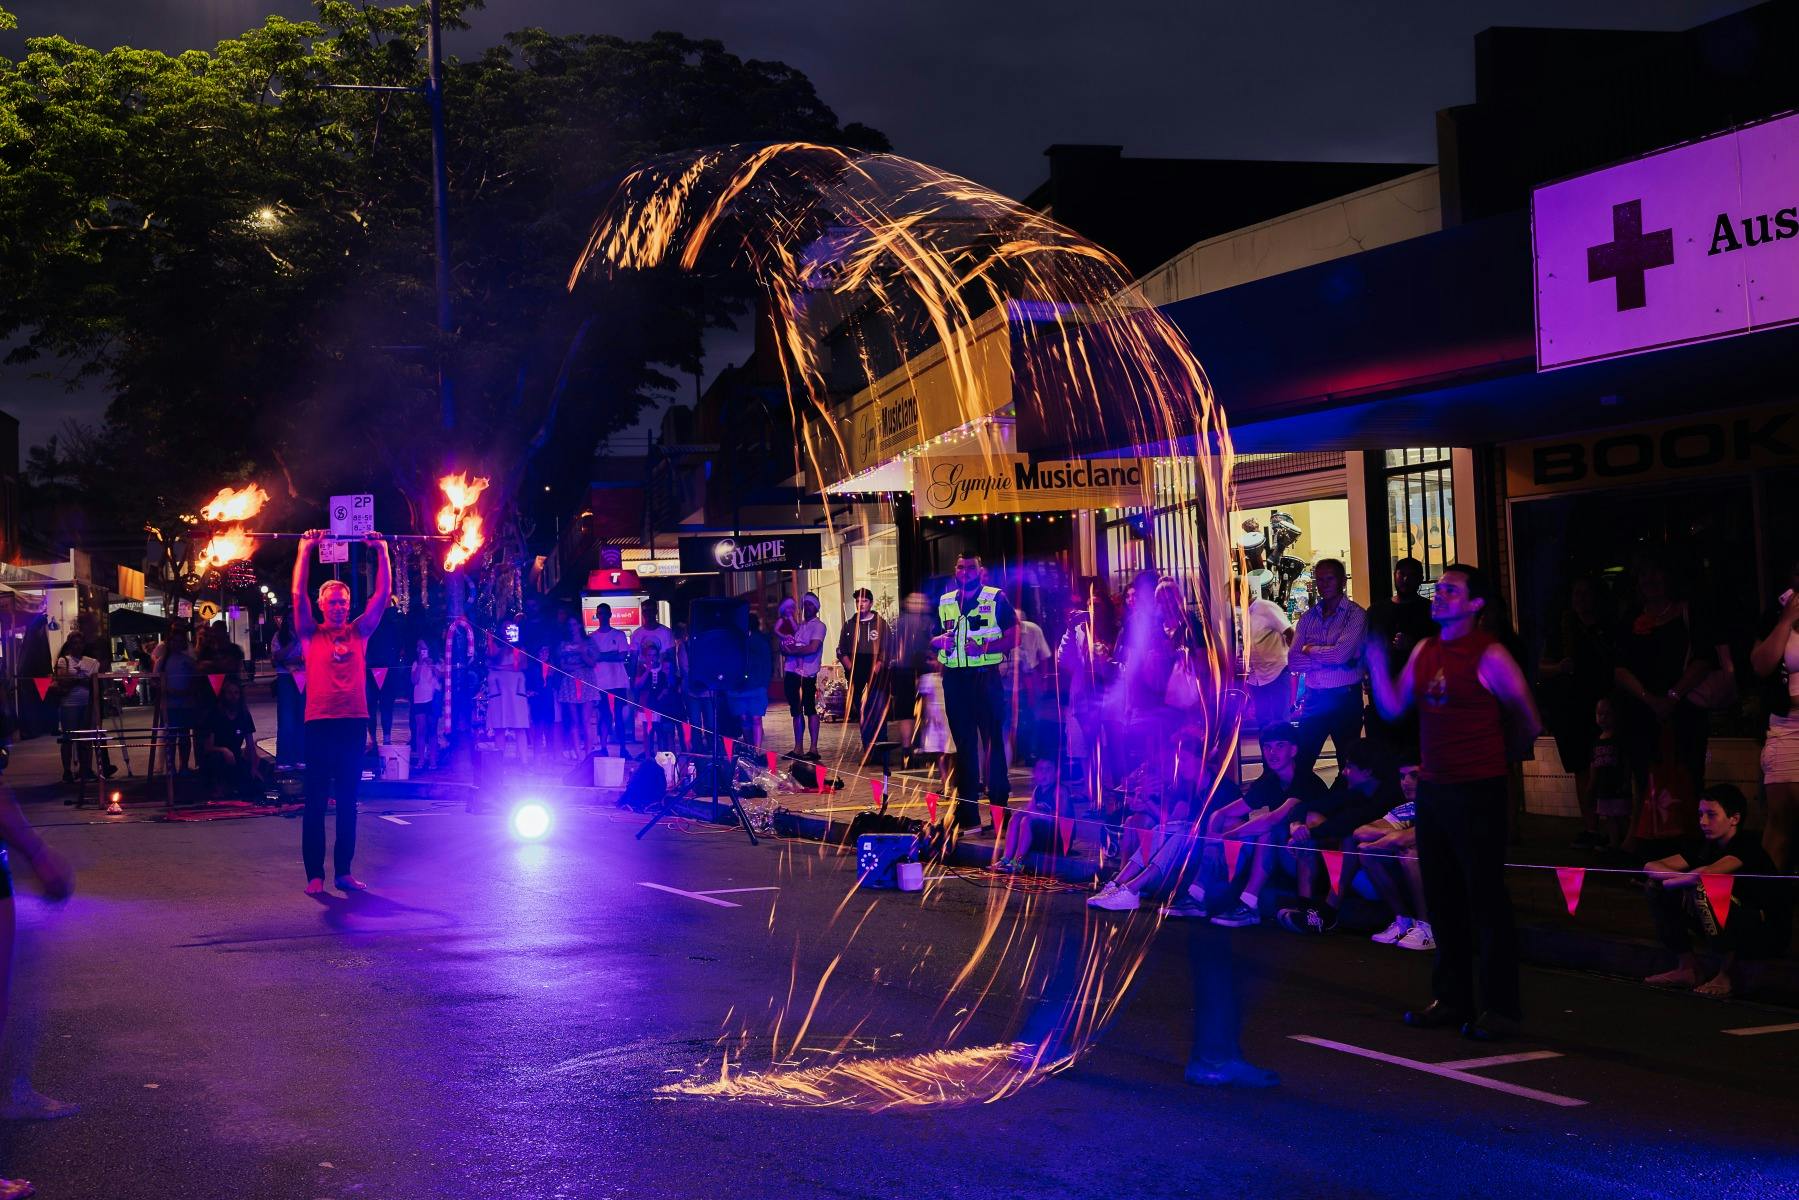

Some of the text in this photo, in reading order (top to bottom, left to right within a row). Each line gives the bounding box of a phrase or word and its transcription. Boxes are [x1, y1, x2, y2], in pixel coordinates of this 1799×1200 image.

[1708, 207, 1799, 256] Aus
[1533, 413, 1793, 485] BOOK
[354, 496, 372, 508] 2P
[927, 457, 1142, 509] Gympie Musicland
[715, 539, 785, 569] GYMPIE
